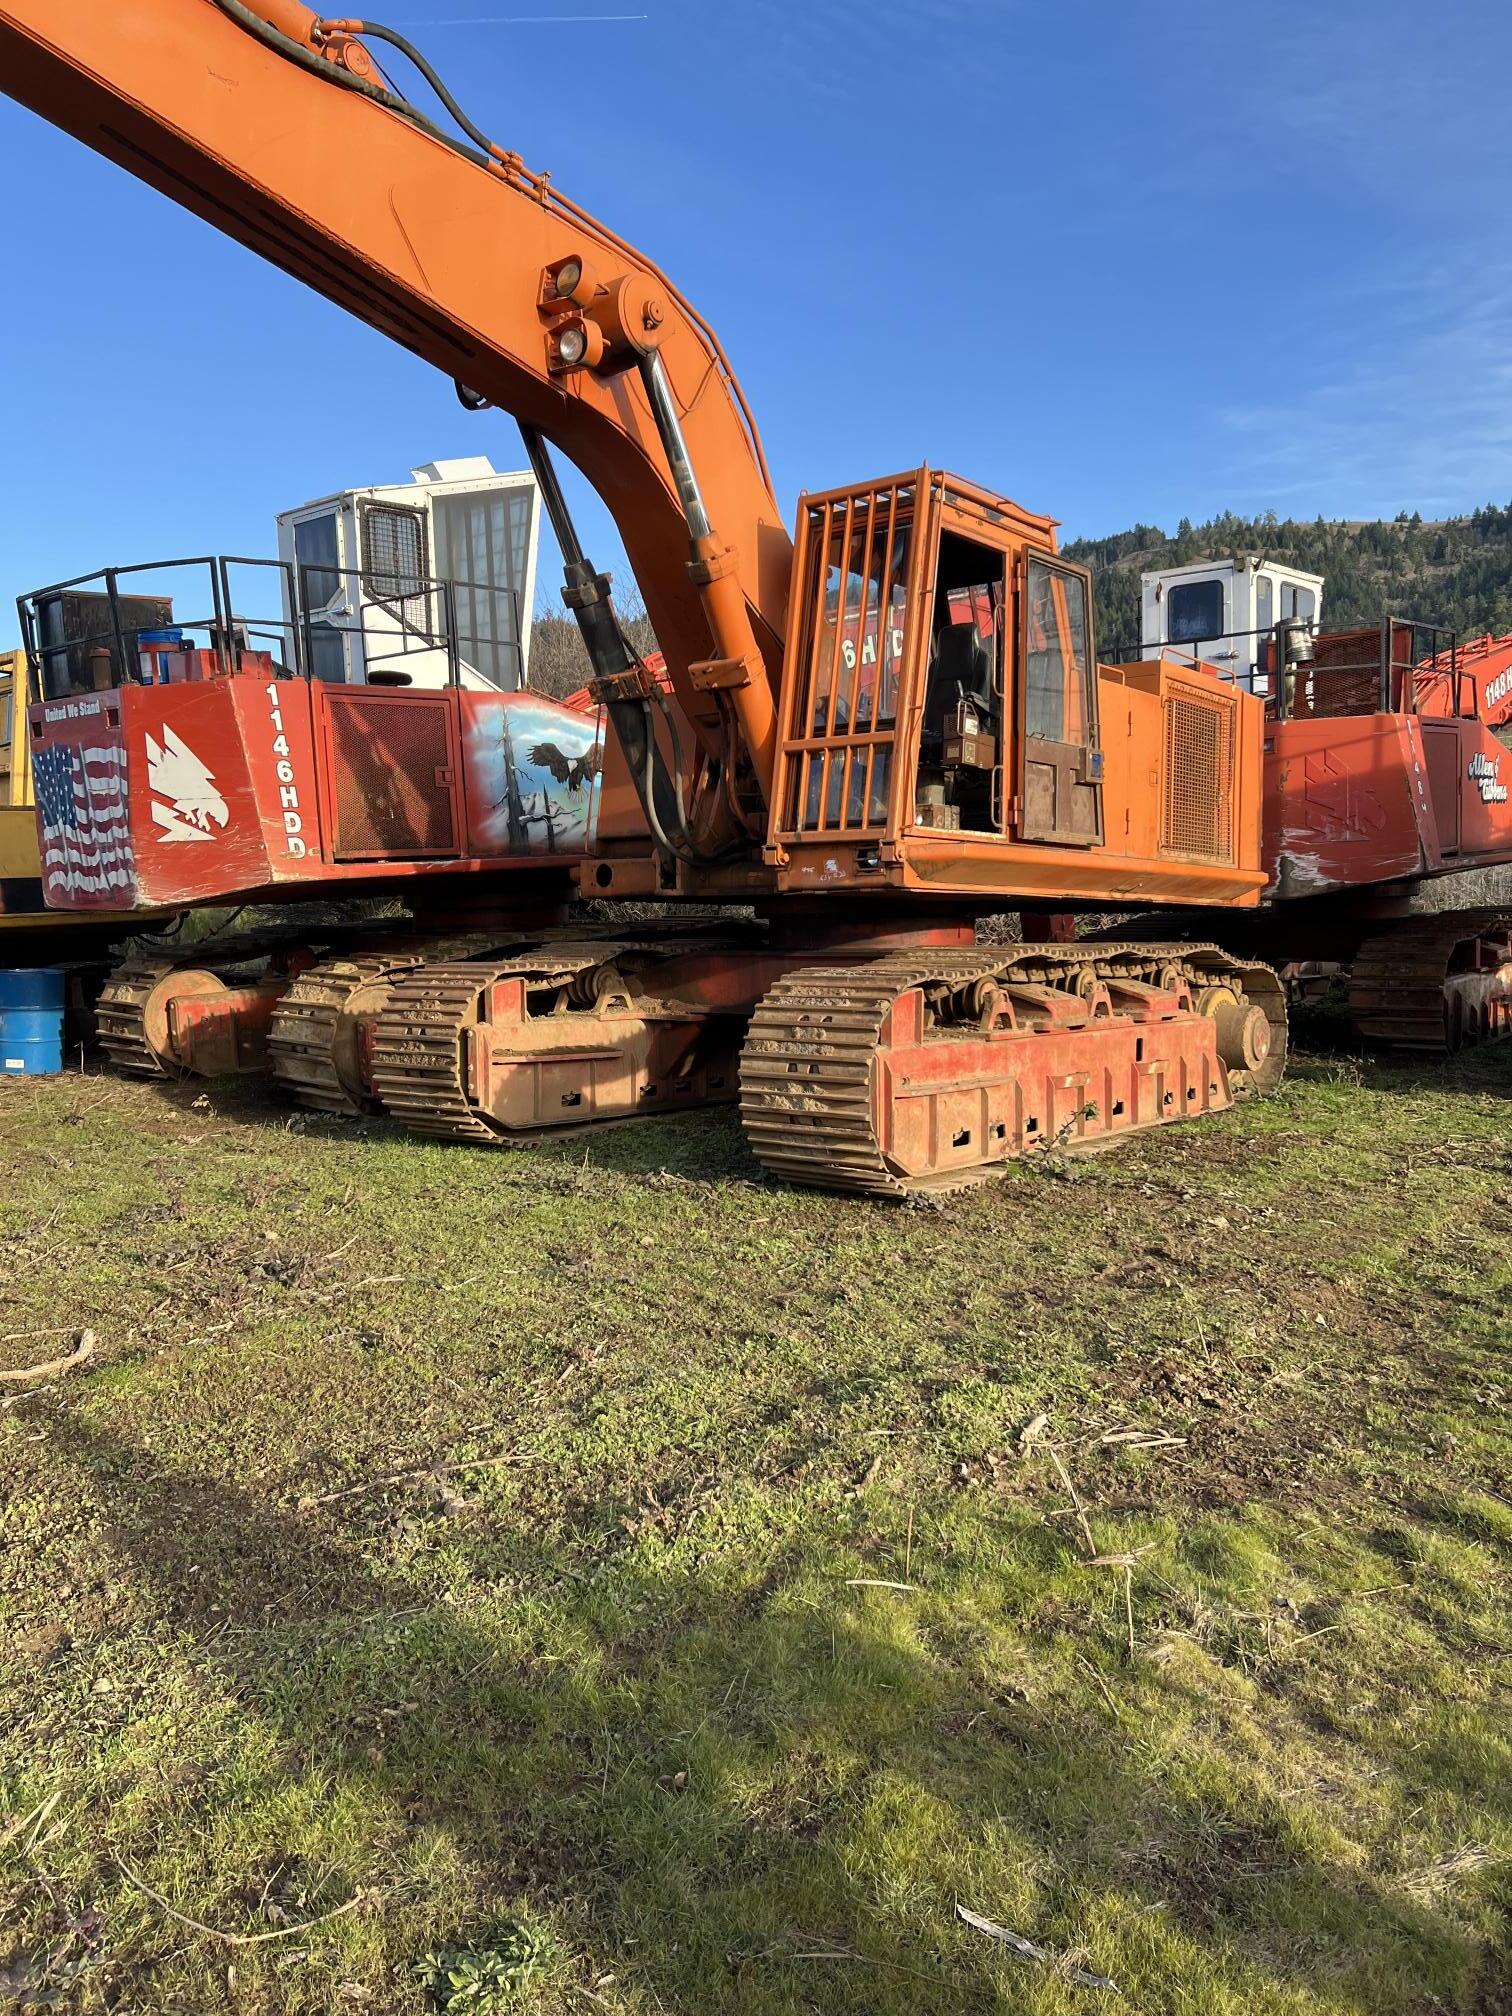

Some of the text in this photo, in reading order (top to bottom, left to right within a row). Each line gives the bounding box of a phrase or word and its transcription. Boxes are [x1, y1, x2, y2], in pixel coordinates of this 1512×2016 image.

[45, 699, 101, 722] United We Stand
[265, 682, 306, 859] 1146HDD
